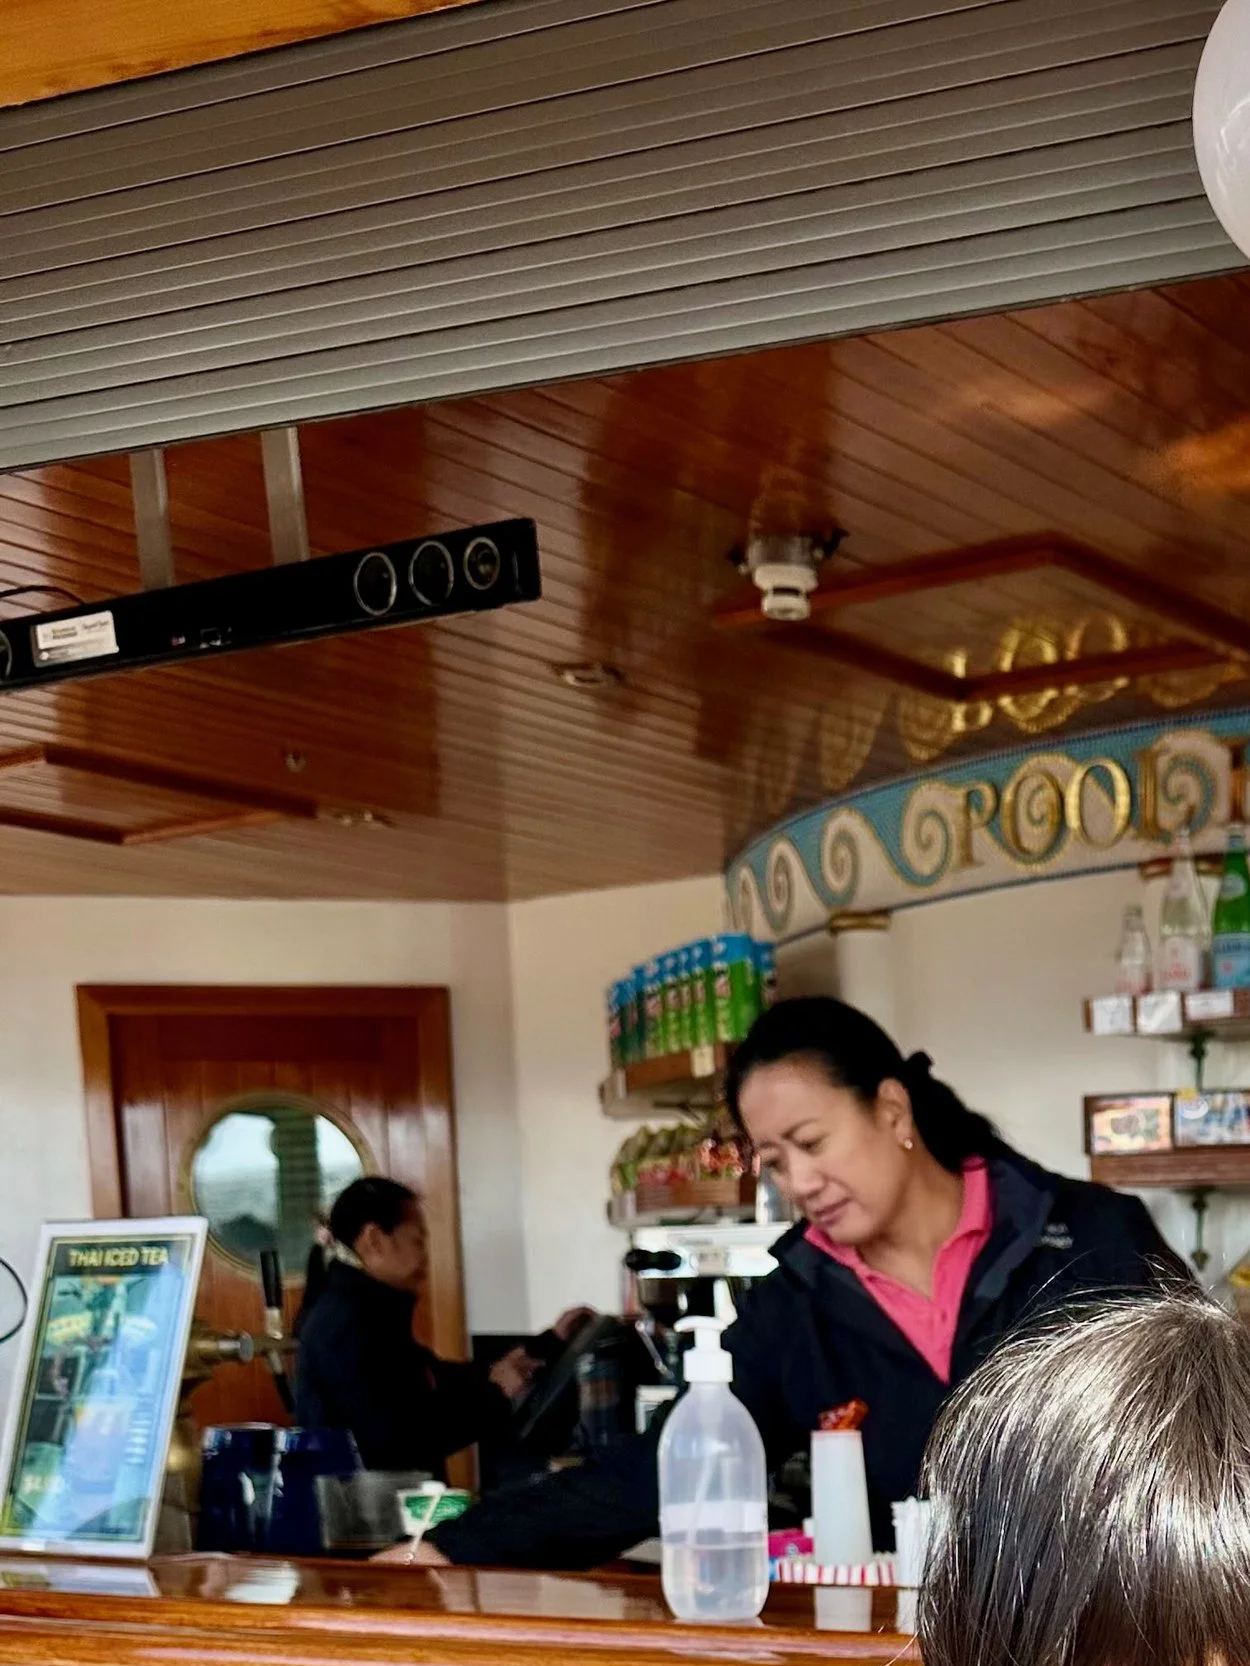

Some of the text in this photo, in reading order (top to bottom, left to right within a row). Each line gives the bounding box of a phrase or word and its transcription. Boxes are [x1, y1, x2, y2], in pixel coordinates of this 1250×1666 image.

[953, 748, 1195, 868] POOL
[68, 1245, 169, 1267] THAI ICED TEA
